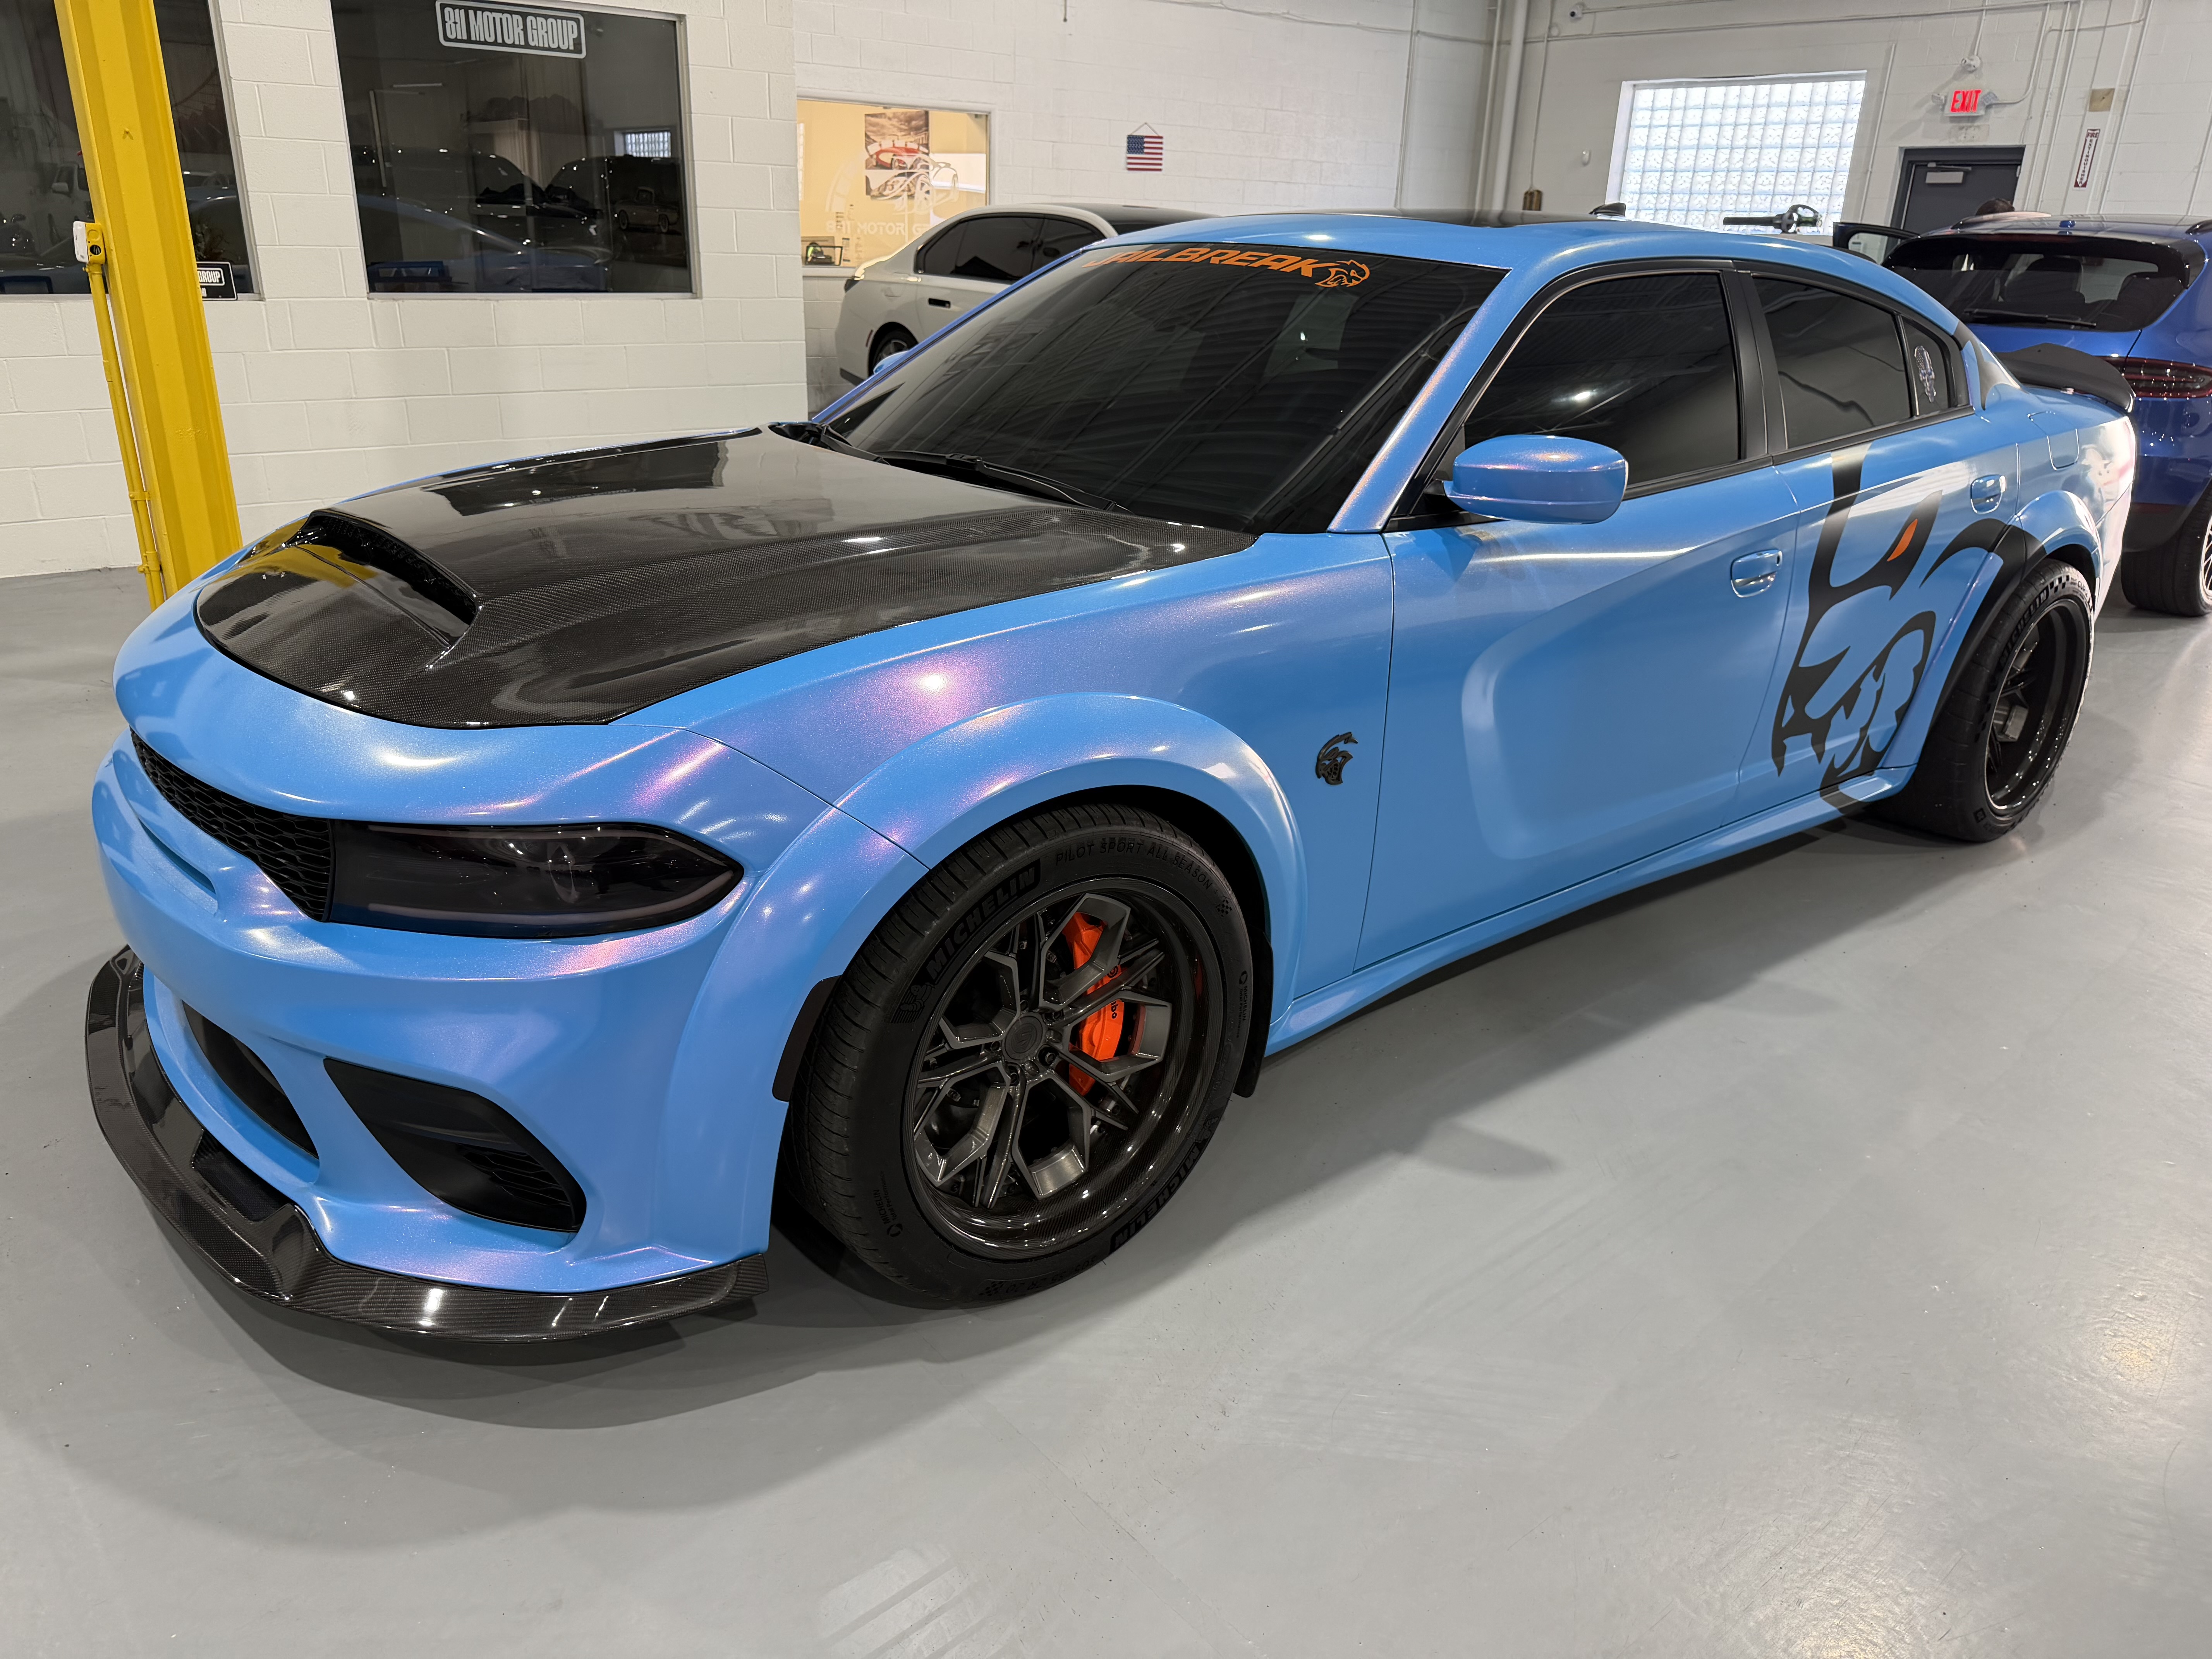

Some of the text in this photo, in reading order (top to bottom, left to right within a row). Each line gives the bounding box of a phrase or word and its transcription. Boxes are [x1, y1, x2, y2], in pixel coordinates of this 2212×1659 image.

[468, 10, 525, 45] MOTOR
[526, 15, 578, 50] GROUP
[1950, 89, 1982, 112] EXIT
[857, 222, 905, 235] MOTOR
[198, 270, 220, 283] GROUP
[1082, 248, 1340, 277] JAILBREAK
[1056, 842, 1213, 889] PILOT SPORT ALL SEASON
[926, 867, 1035, 980] MICHELIN
[873, 1189, 891, 1225] MICHELIN
[888, 1207, 897, 1220] Total
